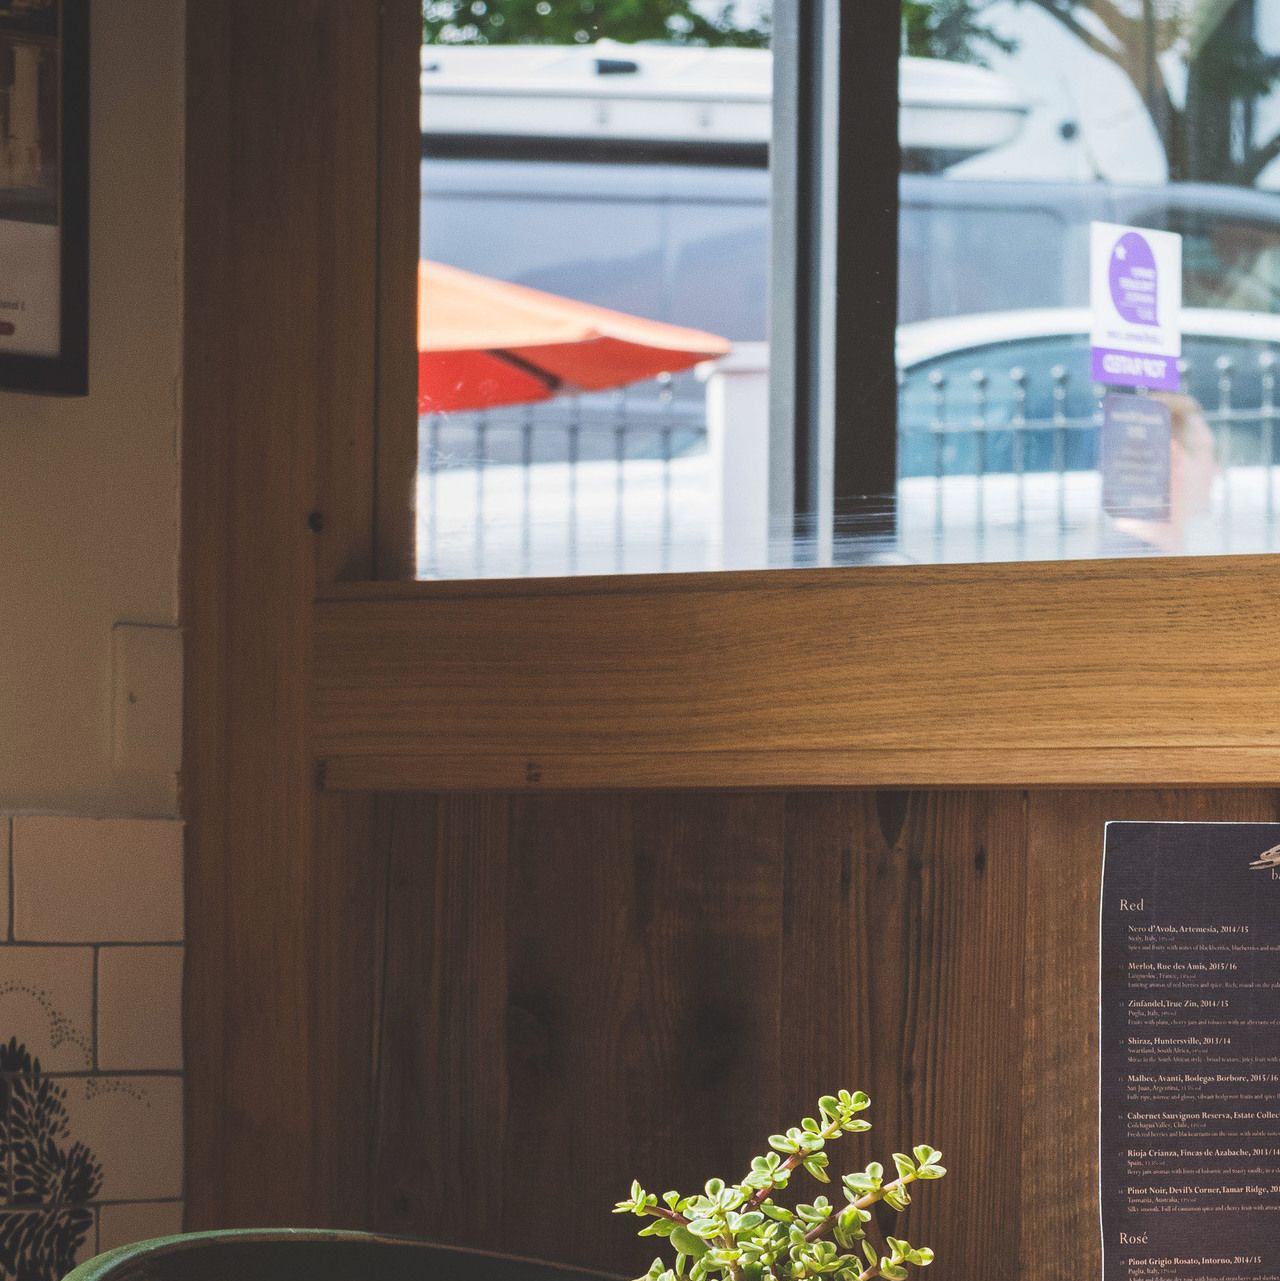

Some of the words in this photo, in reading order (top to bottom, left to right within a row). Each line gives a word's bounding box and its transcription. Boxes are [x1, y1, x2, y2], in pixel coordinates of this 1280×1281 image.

[1120, 898, 1144, 911] Red
[1179, 926, 1219, 934] Artemesia,
[1128, 962, 1156, 971] Merlot,
[1173, 962, 1186, 970] des
[1187, 962, 1208, 971] Amis,
[1209, 962, 1237, 970] 2015/16
[1128, 999, 1166, 1008] Zinfandel,
[1184, 999, 1199, 1008] Zin,
[1128, 1037, 1153, 1046] Shiraz,
[1154, 1037, 1202, 1046] Huntersville,
[1128, 1074, 1157, 1083] Malbec,
[1158, 1074, 1183, 1083] Avanti,
[1184, 1074, 1215, 1084] Bodegas
[1216, 1074, 1249, 1083] Borbore,
[1162, 1111, 1200, 1121] Sauvignon
[1202, 1111, 1232, 1120] Reserva,
[1127, 1149, 1147, 1159] Rioja
[1148, 1149, 1179, 1158] Crianza,
[1214, 1149, 1251, 1157] Azabache,
[1127, 1186, 1148, 1194] Pinot
[1149, 1186, 1168, 1195] Noir,
[1194, 1186, 1222, 1194] Corner,
[1222, 1185, 1244, 1193] Tamar
[1245, 1185, 1269, 1195] Ridge,
[1120, 1231, 1148, 1244] Rosé
[1149, 1257, 1172, 1267] Grigio
[1174, 1257, 1200, 1266] Rosato,
[1202, 1256, 1232, 1265] Intorno,
